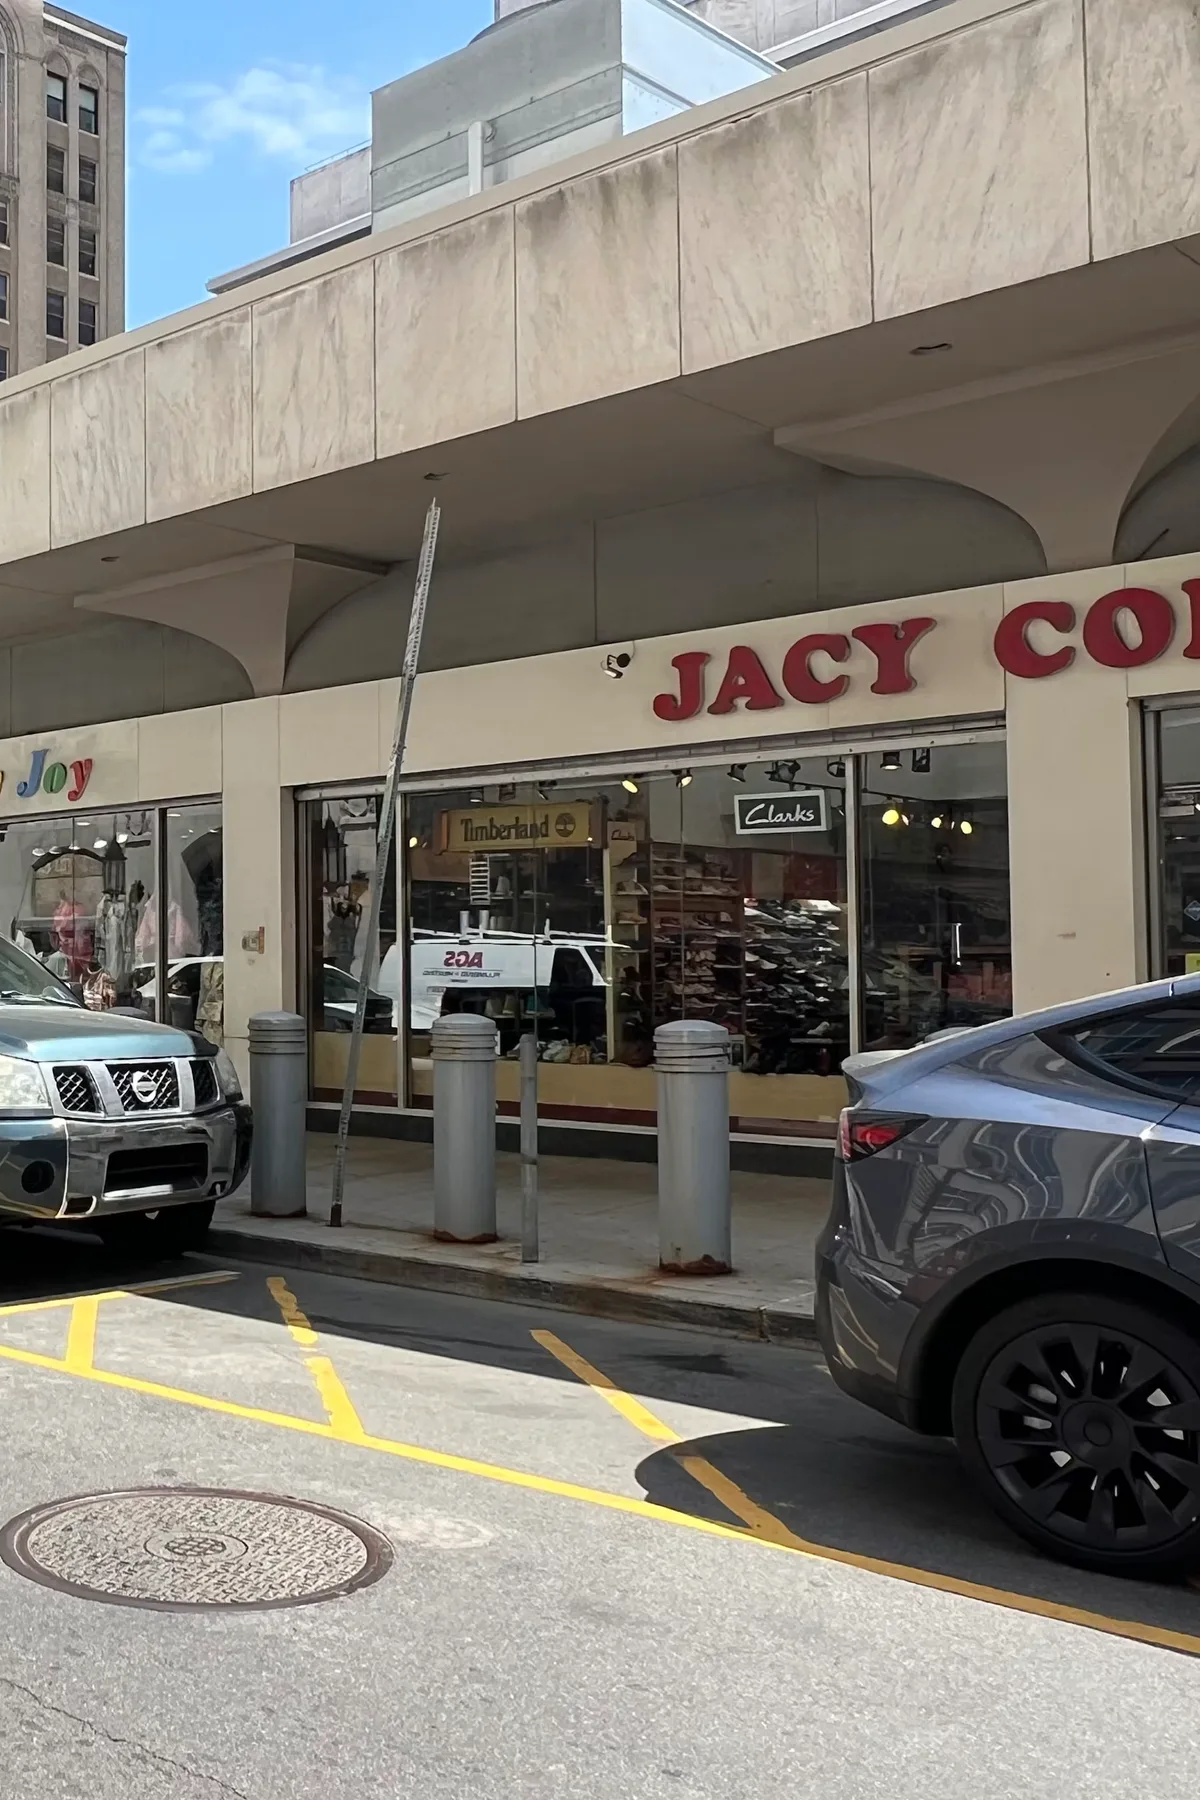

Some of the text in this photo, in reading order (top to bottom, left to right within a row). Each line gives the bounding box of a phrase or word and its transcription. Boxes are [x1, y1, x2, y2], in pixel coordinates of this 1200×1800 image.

[653, 579, 1200, 722] JACY CO
[16, 748, 93, 802] Joy
[460, 814, 549, 842] Timberland
[745, 803, 815, 825] Clarks
